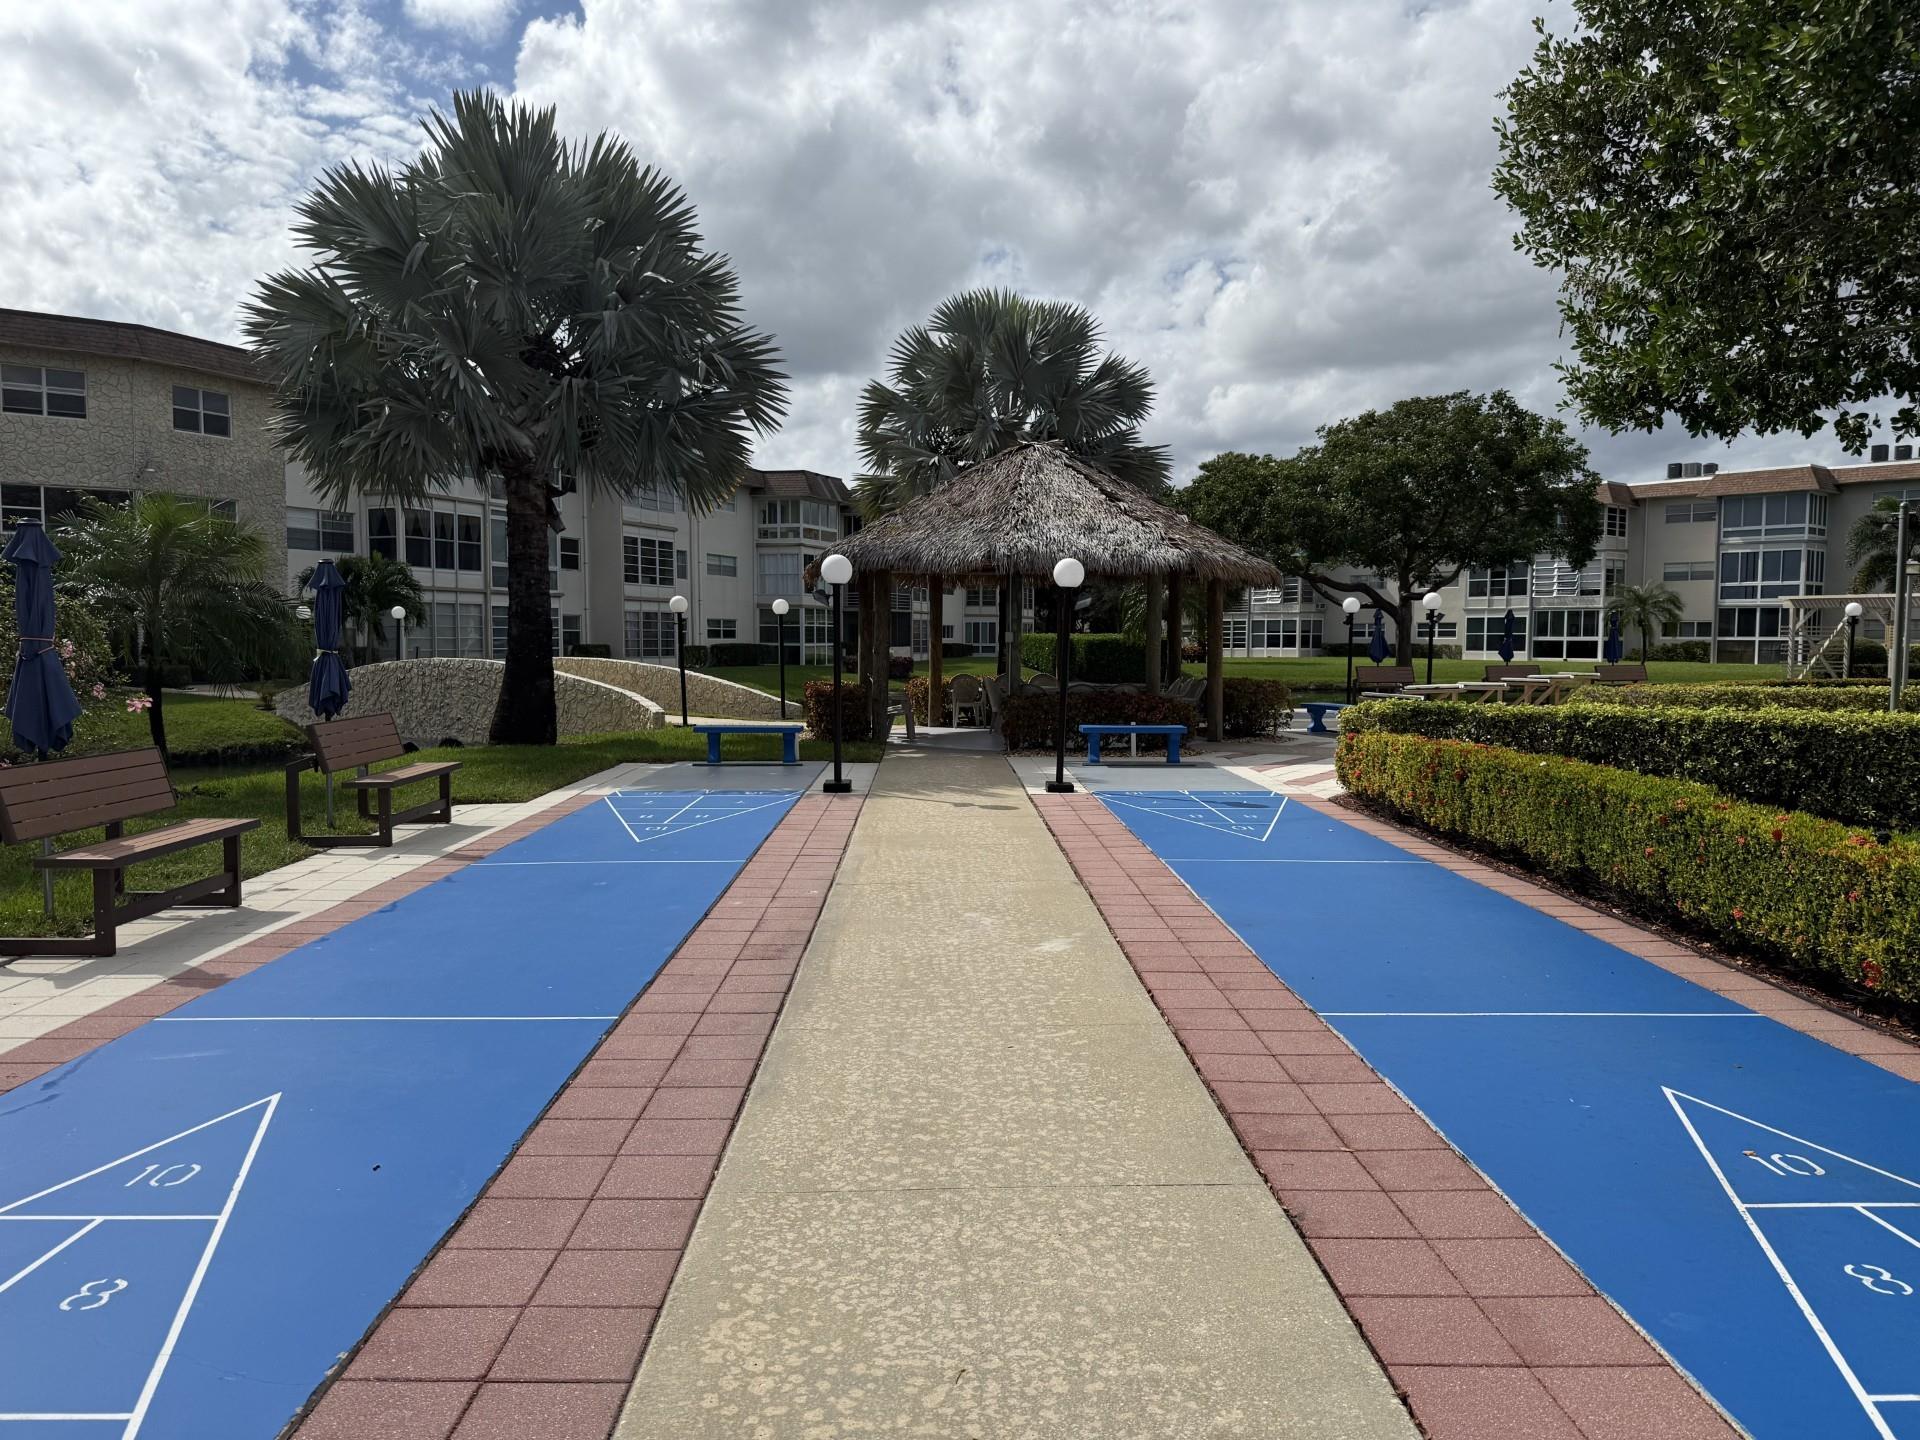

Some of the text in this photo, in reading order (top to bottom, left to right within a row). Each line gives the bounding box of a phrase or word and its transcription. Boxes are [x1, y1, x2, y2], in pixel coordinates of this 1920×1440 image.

[124, 1163, 202, 1187] 10
[1748, 1153, 1826, 1176] 10
[1844, 1264, 1913, 1295] 8
[59, 1278, 128, 1311] 8
